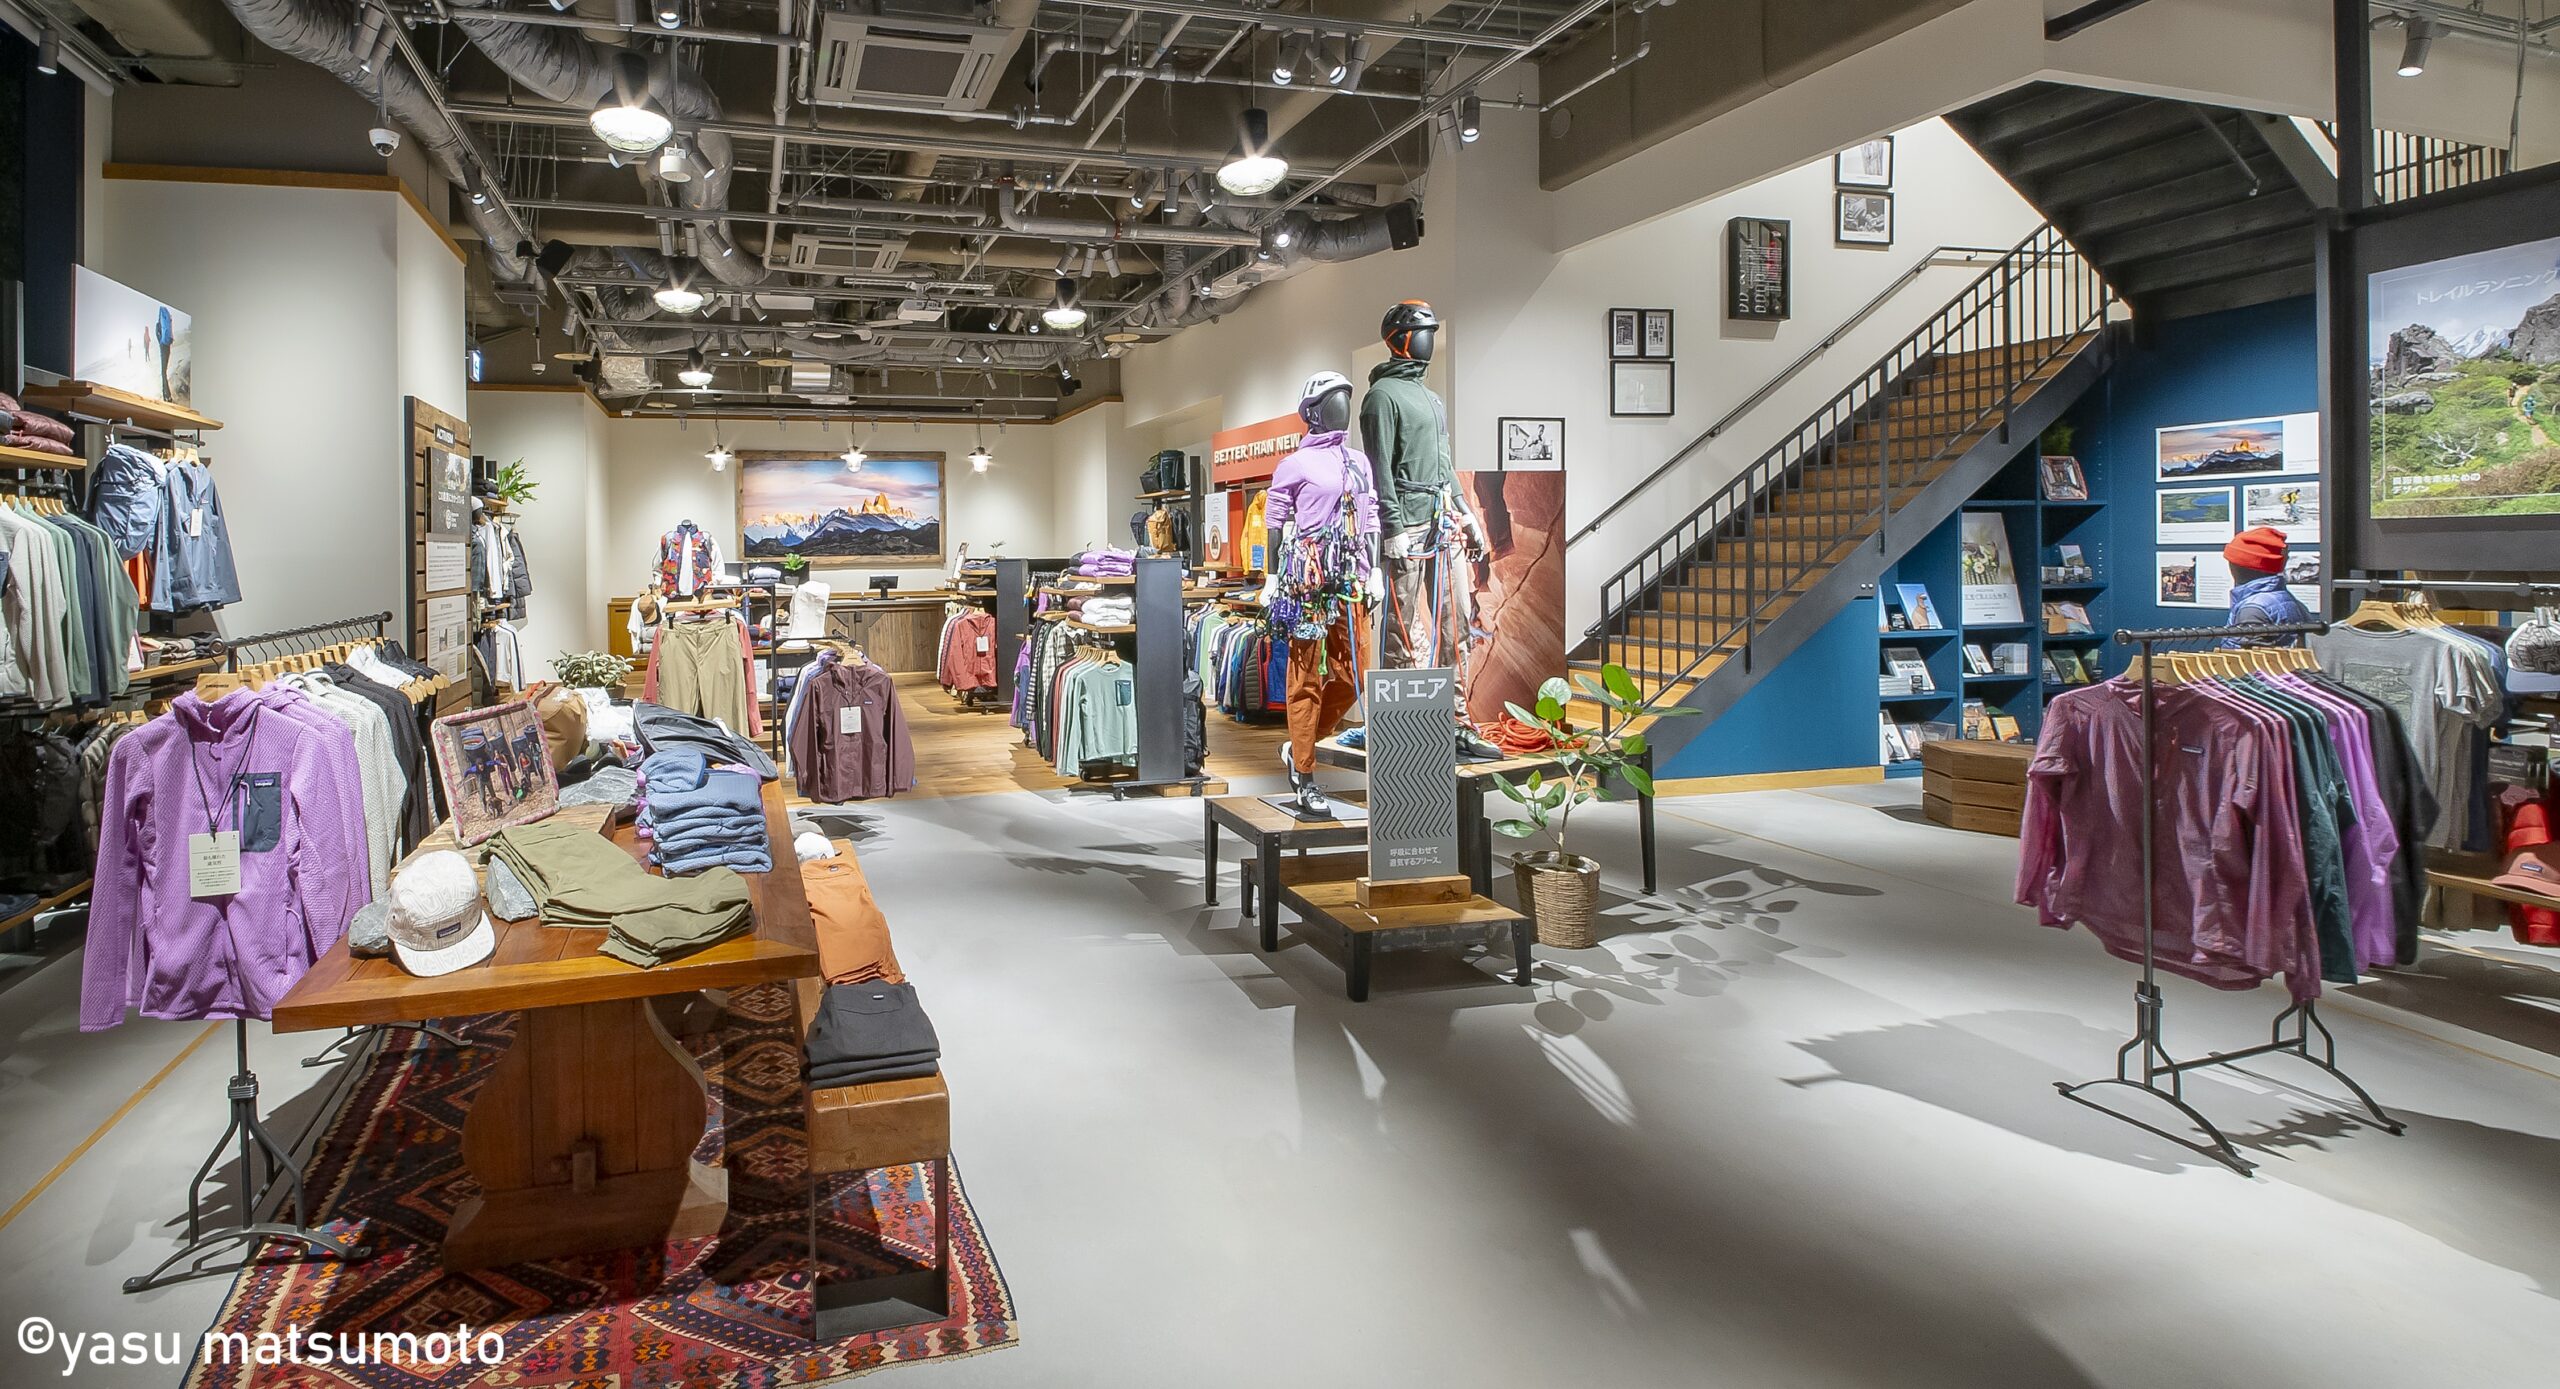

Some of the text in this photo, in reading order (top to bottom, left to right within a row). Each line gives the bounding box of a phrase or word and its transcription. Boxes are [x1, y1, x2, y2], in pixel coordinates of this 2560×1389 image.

[2416, 268, 2558, 306] トレイルランニング
[1214, 433, 1301, 464] BETTER THAN NEW
[1406, 677, 1448, 700] エア
[1389, 846, 1439, 857] 呼吸に合わせて
